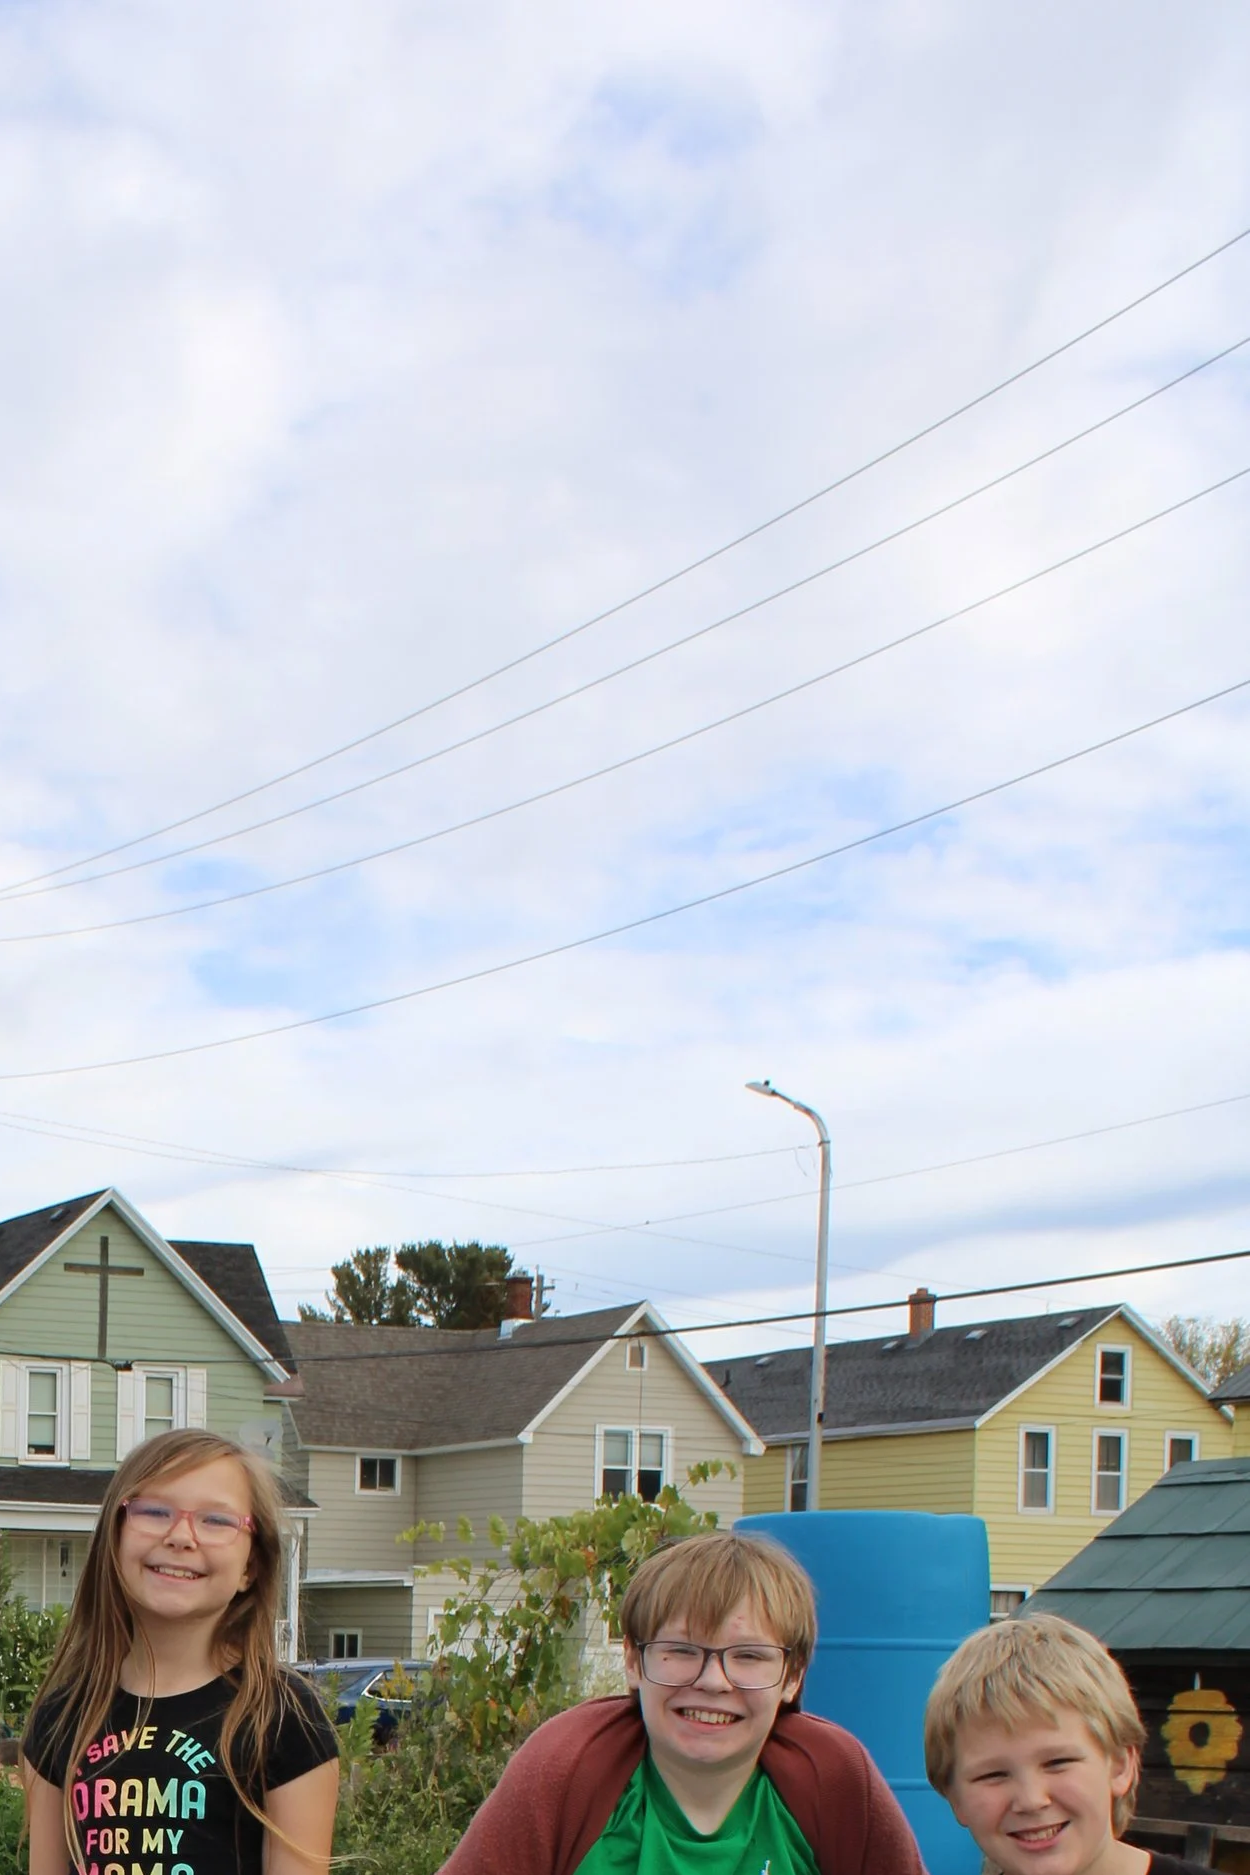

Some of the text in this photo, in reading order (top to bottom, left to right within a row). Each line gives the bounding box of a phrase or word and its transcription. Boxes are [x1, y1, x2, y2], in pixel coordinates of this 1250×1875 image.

[86, 1726, 217, 1775] SAVE THE
[71, 1777, 207, 1820] DRAMA
[85, 1828, 184, 1856] FOR MY
